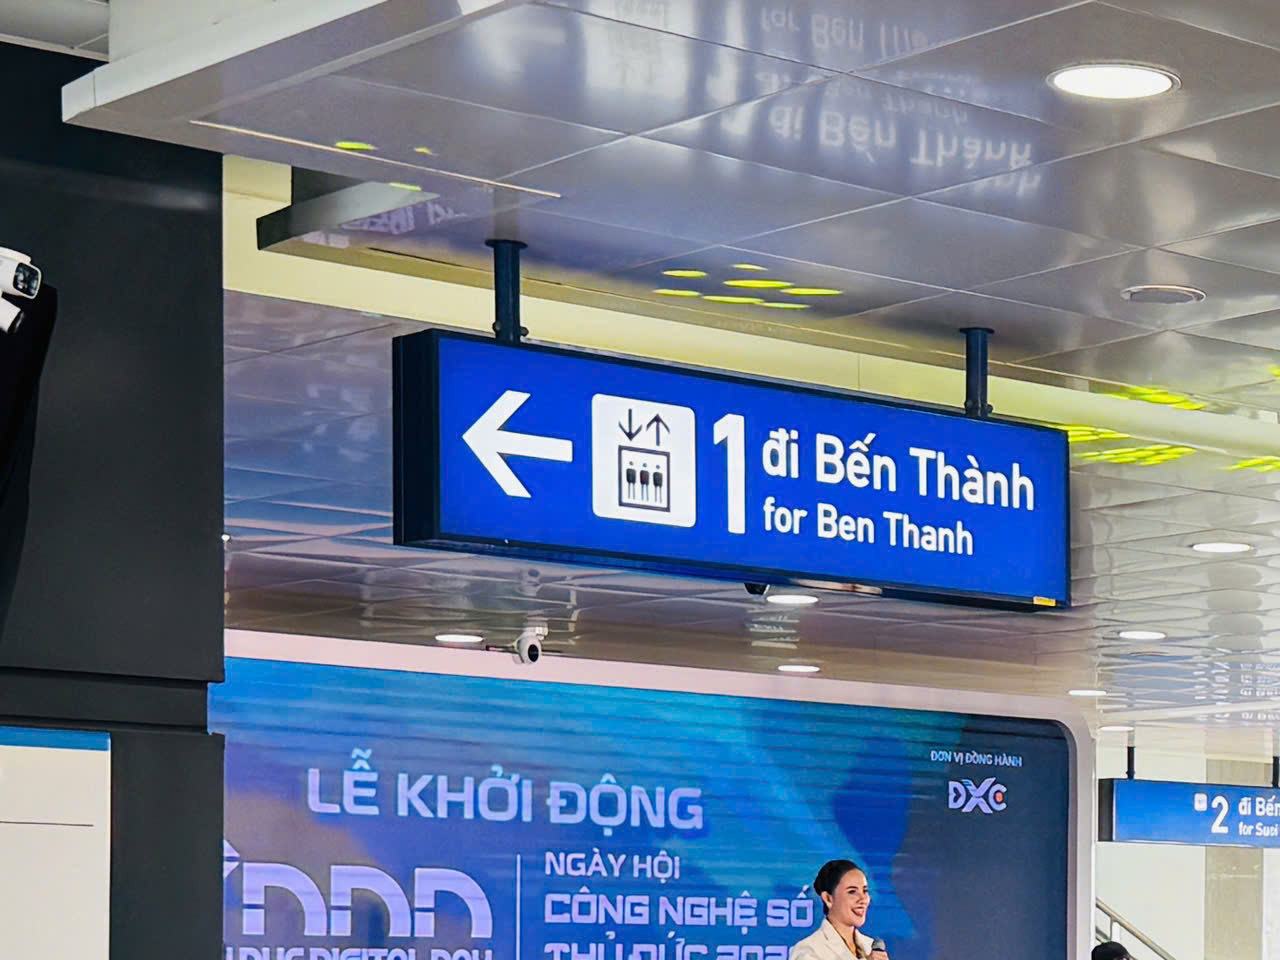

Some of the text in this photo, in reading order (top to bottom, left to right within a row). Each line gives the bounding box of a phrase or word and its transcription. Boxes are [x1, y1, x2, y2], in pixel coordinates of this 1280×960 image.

[713, 413, 746, 534] 1
[762, 428, 1035, 511] đi Bến Thành
[762, 496, 974, 556] for Ben Thanh
[930, 750, 952, 762] ĐƠN
[307, 747, 704, 837] LỄ KHỞI ĐỘNG
[948, 777, 1008, 814] DXC
[1238, 797, 1252, 816] đi
[1211, 795, 1229, 834] 2
[1238, 822, 1254, 836] for
[544, 848, 680, 884] NGÀY HỘI
[544, 884, 814, 935] CÔNG NGHỆ SỐ
